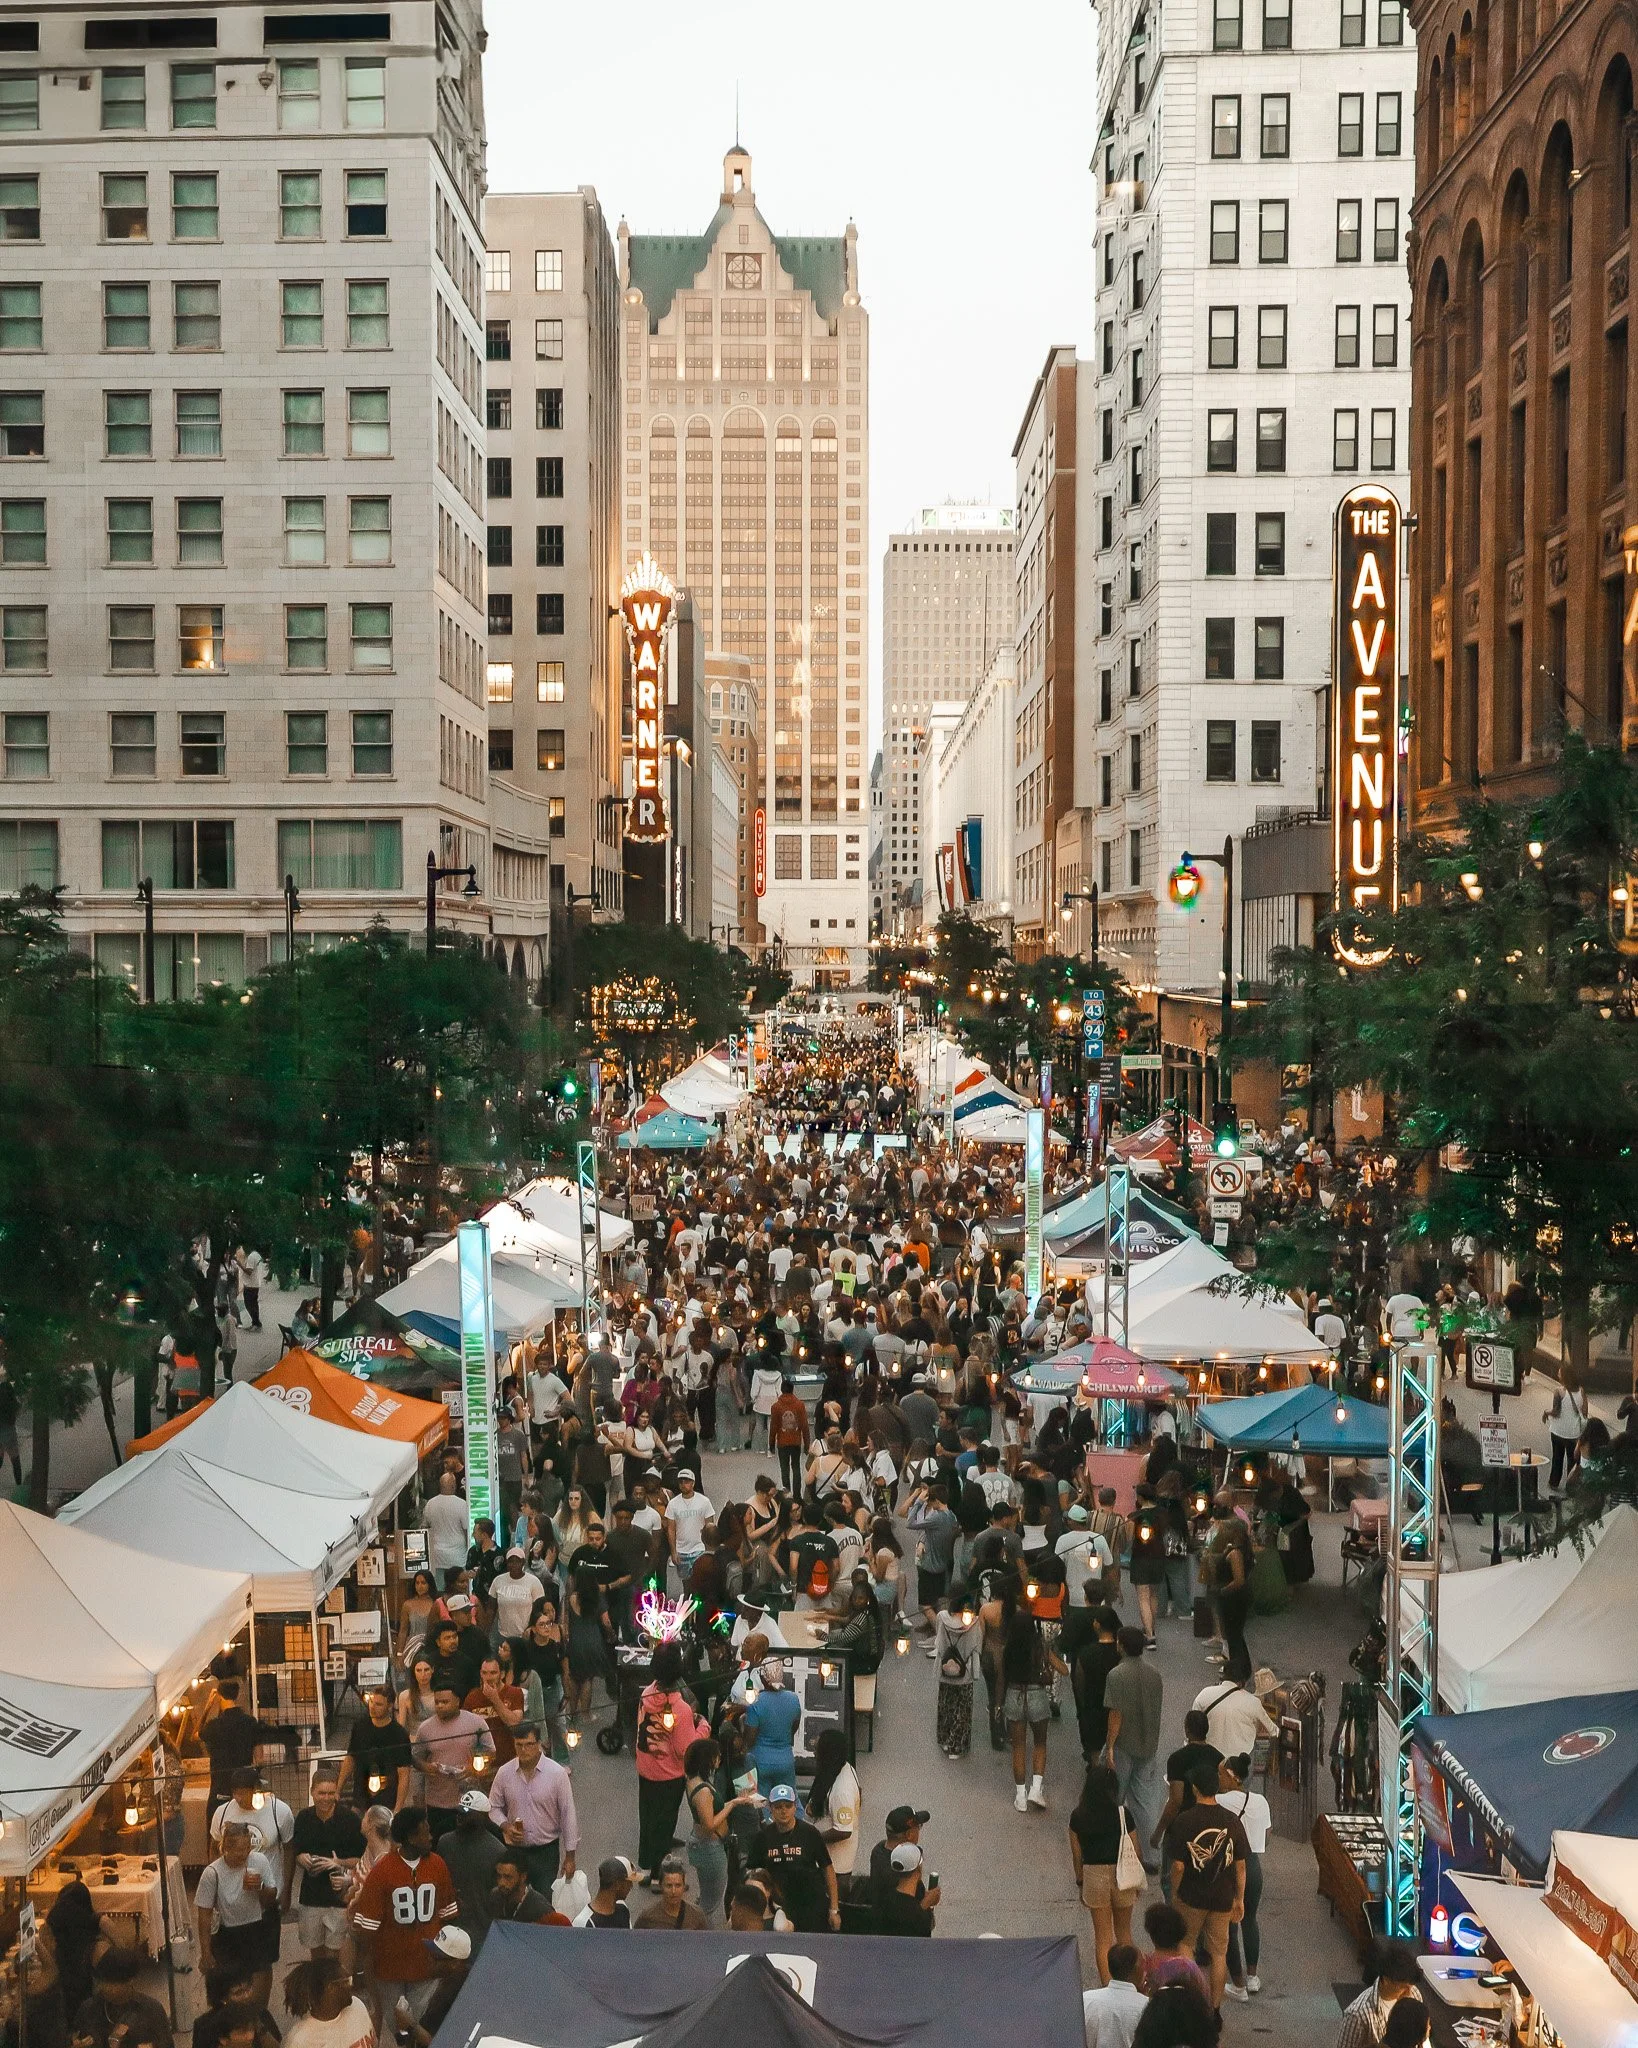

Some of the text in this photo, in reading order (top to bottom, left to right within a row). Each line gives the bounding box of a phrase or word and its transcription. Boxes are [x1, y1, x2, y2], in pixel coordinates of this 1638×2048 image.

[1350, 509, 1390, 535] THE
[632, 602, 661, 826] WARNER
[1086, 1005, 1102, 1017] 43
[1085, 1025, 1101, 1037] 94
[1154, 1235, 1179, 1245] abc
[323, 1336, 397, 1355] SURREAL
[339, 1349, 374, 1364] SIPS
[463, 1332, 487, 1426] MILWAUKEE
[351, 1392, 379, 1420] RADIO
[468, 1431, 489, 1480] NIGHT
[1441, 1750, 1504, 1837] PIZZA SHUTTLE
[391, 1883, 436, 1925] 80
